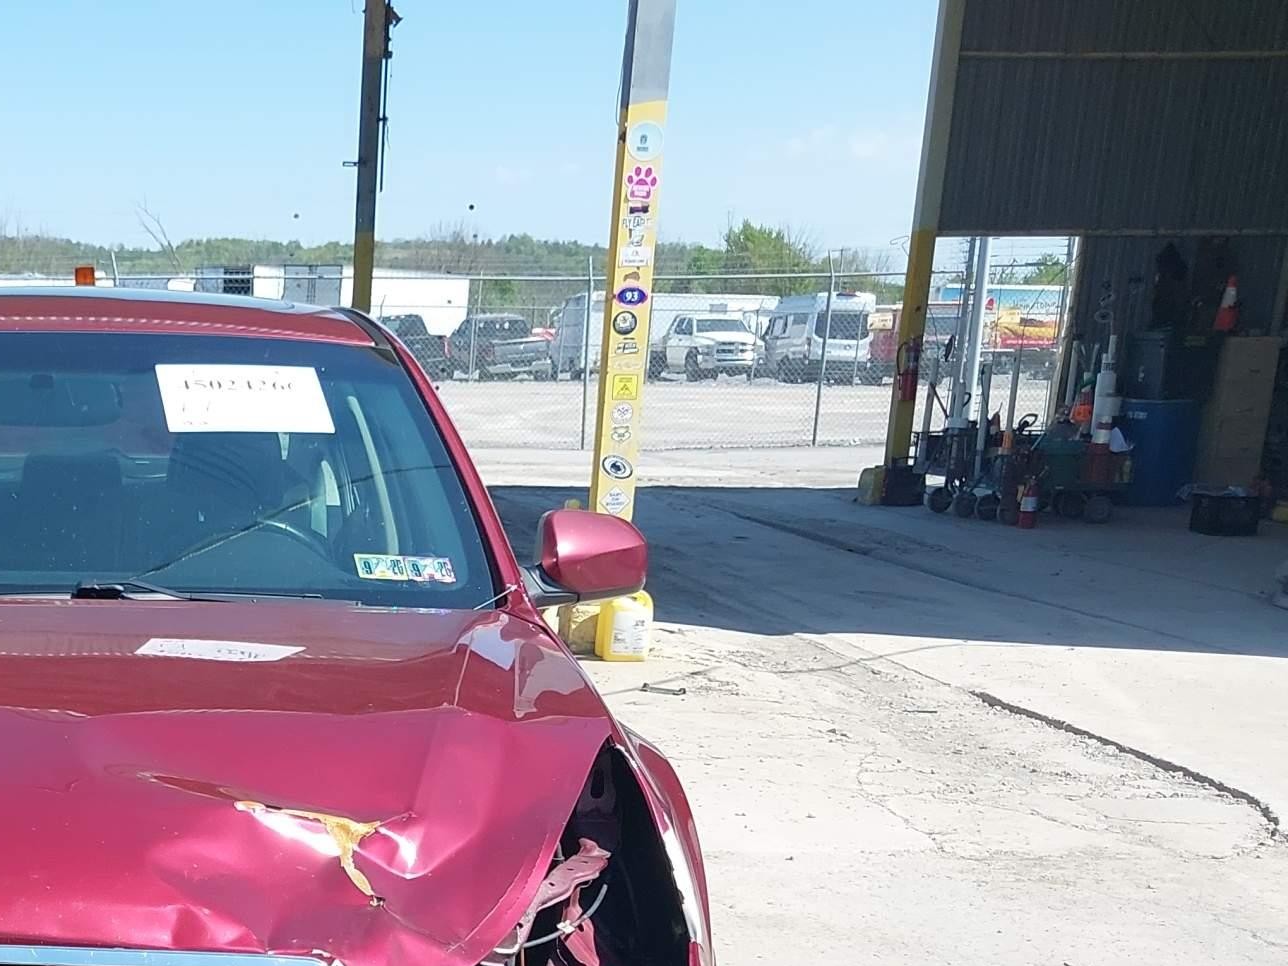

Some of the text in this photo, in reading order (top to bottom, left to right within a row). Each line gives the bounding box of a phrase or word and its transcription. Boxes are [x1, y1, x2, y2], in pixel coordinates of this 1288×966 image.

[625, 291, 639, 302] 93
[363, 560, 373, 575] 9
[411, 563, 422, 578] 9
